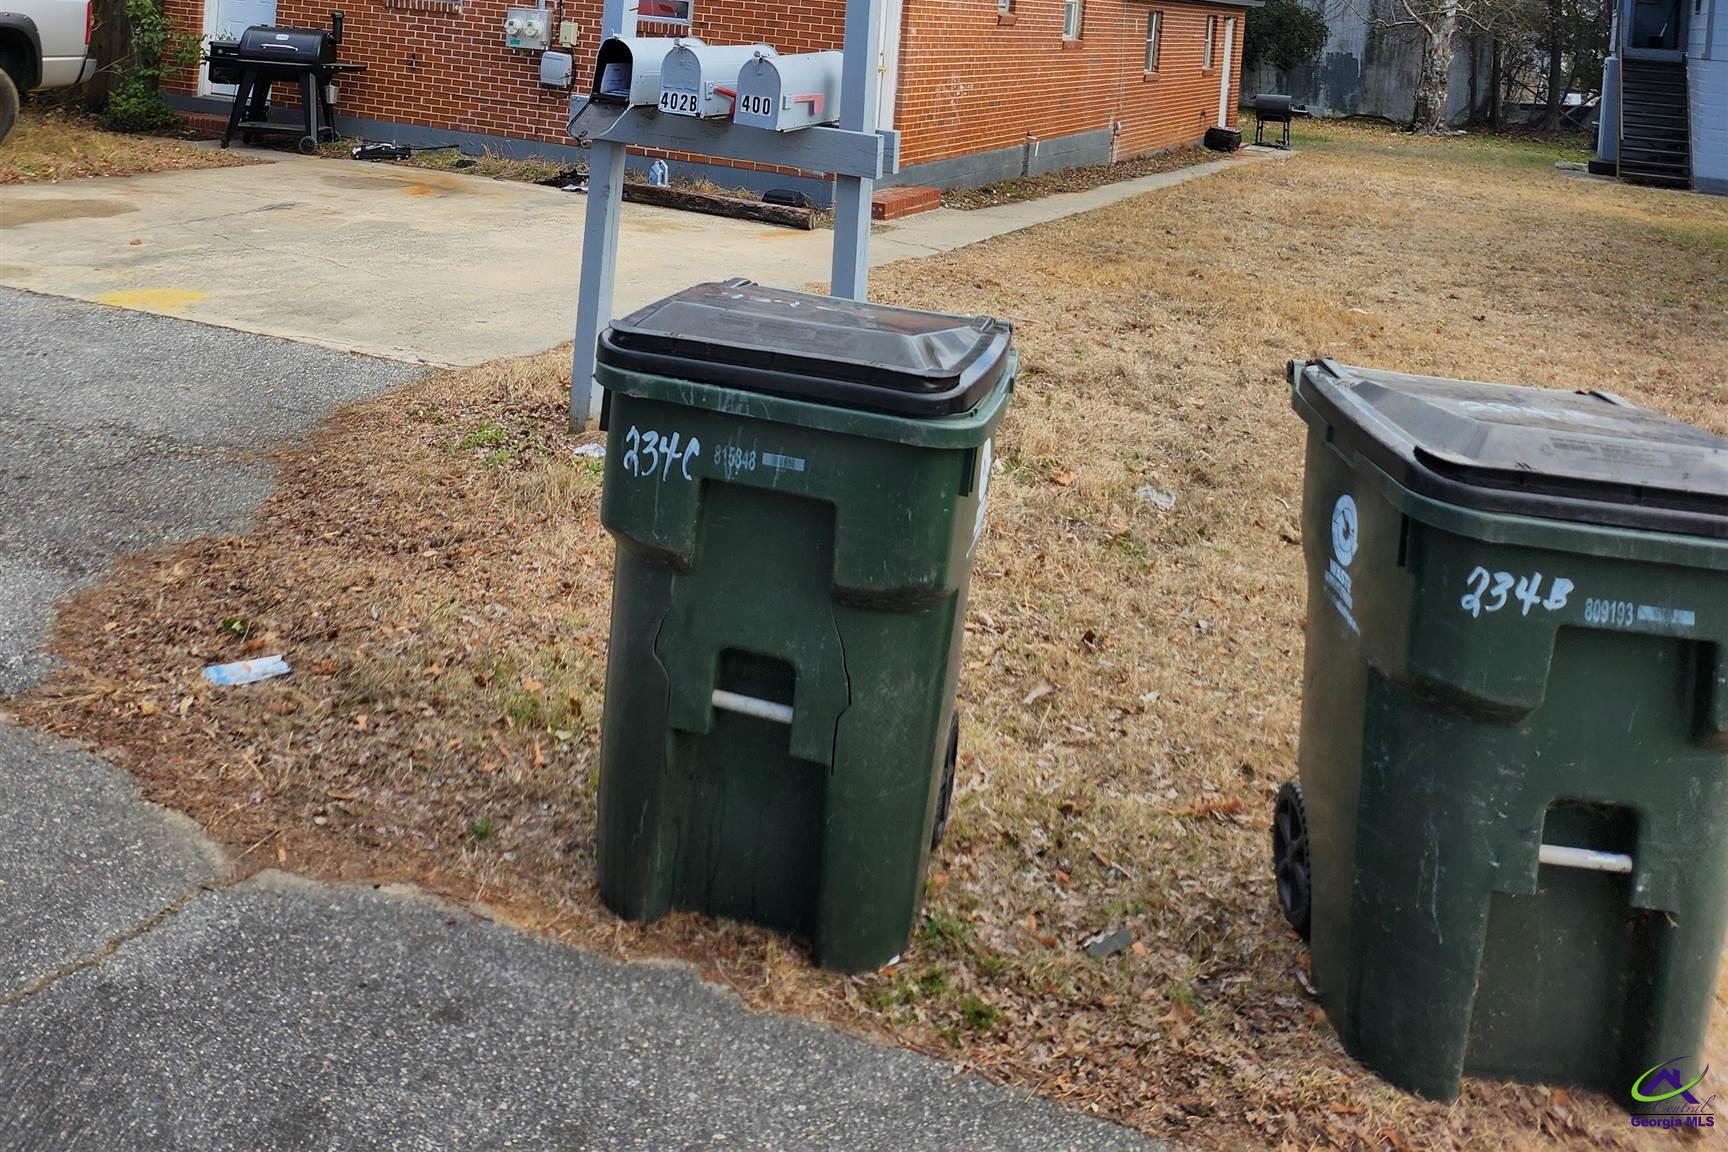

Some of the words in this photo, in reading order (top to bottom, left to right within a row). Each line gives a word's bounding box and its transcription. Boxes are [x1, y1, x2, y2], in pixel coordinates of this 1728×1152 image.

[660, 91, 698, 113] 402B
[741, 95, 771, 115] 400
[623, 425, 700, 482] 234C
[1461, 565, 1575, 619] 234B
[1583, 598, 1635, 626] 809193
